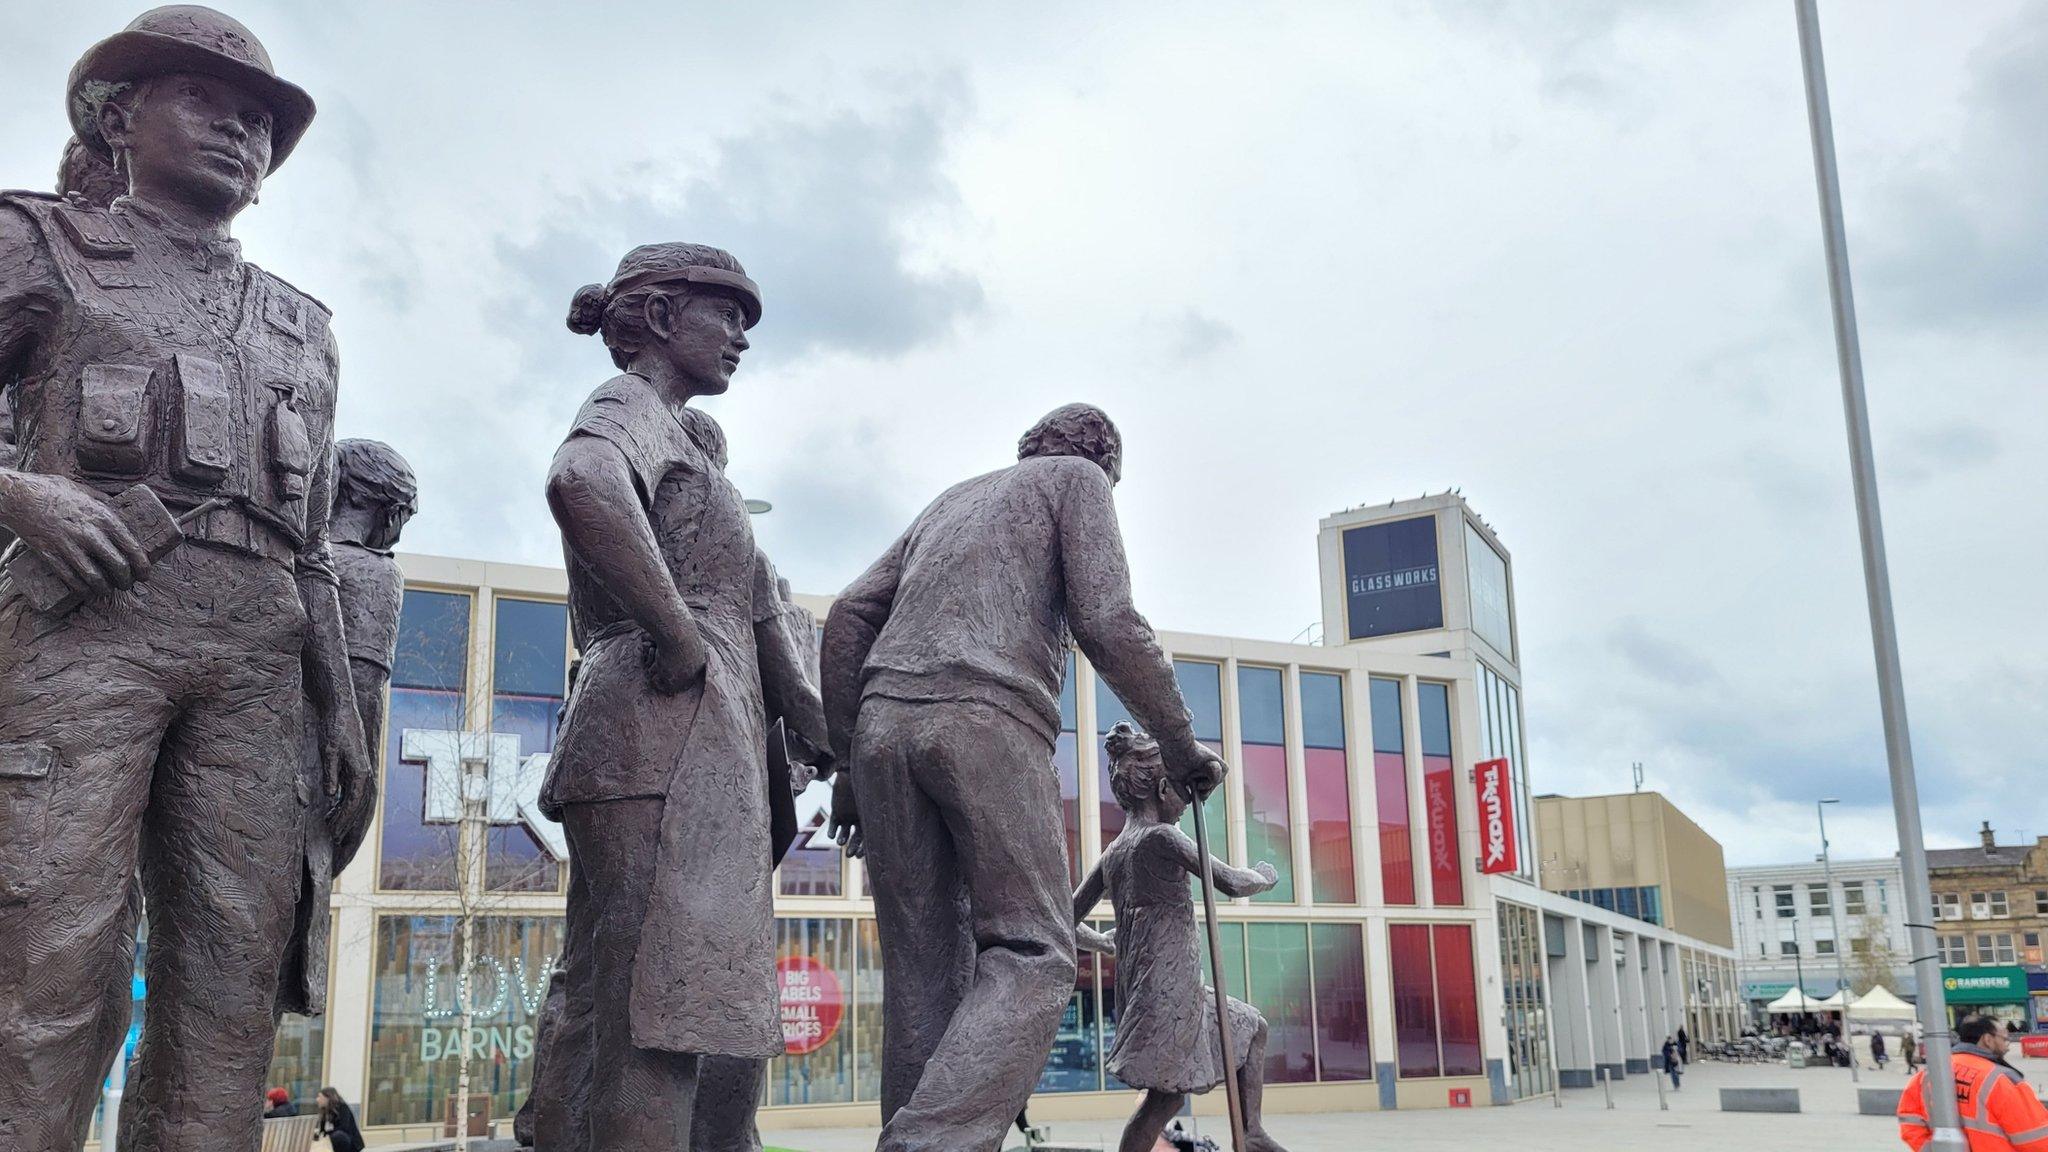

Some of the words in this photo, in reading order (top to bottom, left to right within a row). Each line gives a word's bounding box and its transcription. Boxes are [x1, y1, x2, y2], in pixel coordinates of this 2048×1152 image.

[1352, 568, 1437, 593] GLASSWORKS
[785, 970, 809, 986] BIG
[1957, 977, 2010, 988] RAMSDENS
[423, 956, 552, 1018] LOV
[780, 986, 822, 1003] ABELS
[783, 1021, 822, 1038] RICES
[420, 1024, 534, 1062] BARNS
